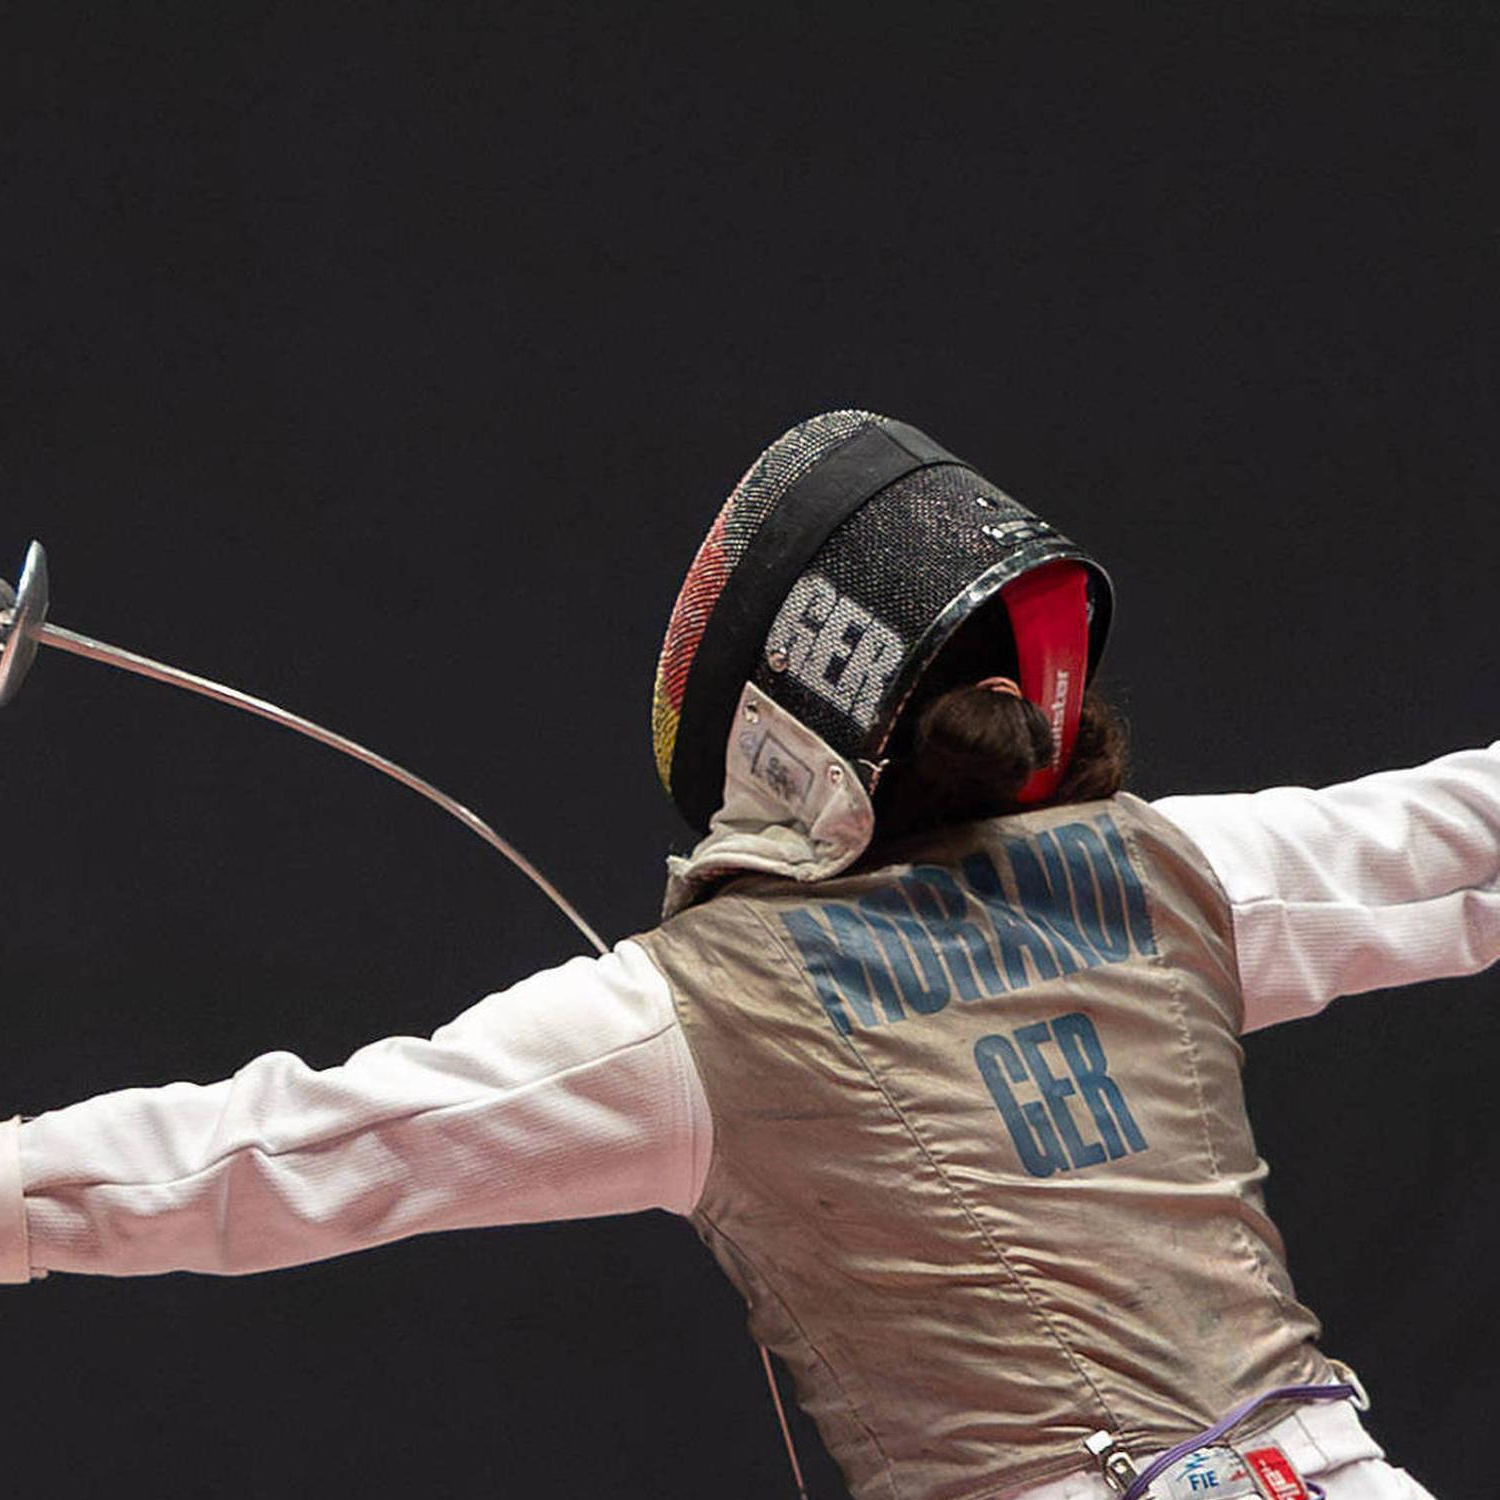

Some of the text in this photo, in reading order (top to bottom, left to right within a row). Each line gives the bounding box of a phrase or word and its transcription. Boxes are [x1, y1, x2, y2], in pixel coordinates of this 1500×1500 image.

[764, 574, 905, 732] GER
[778, 813, 1158, 1035] MORANDI
[974, 1012, 1149, 1178] GER
[1188, 1470, 1219, 1491] FIE
